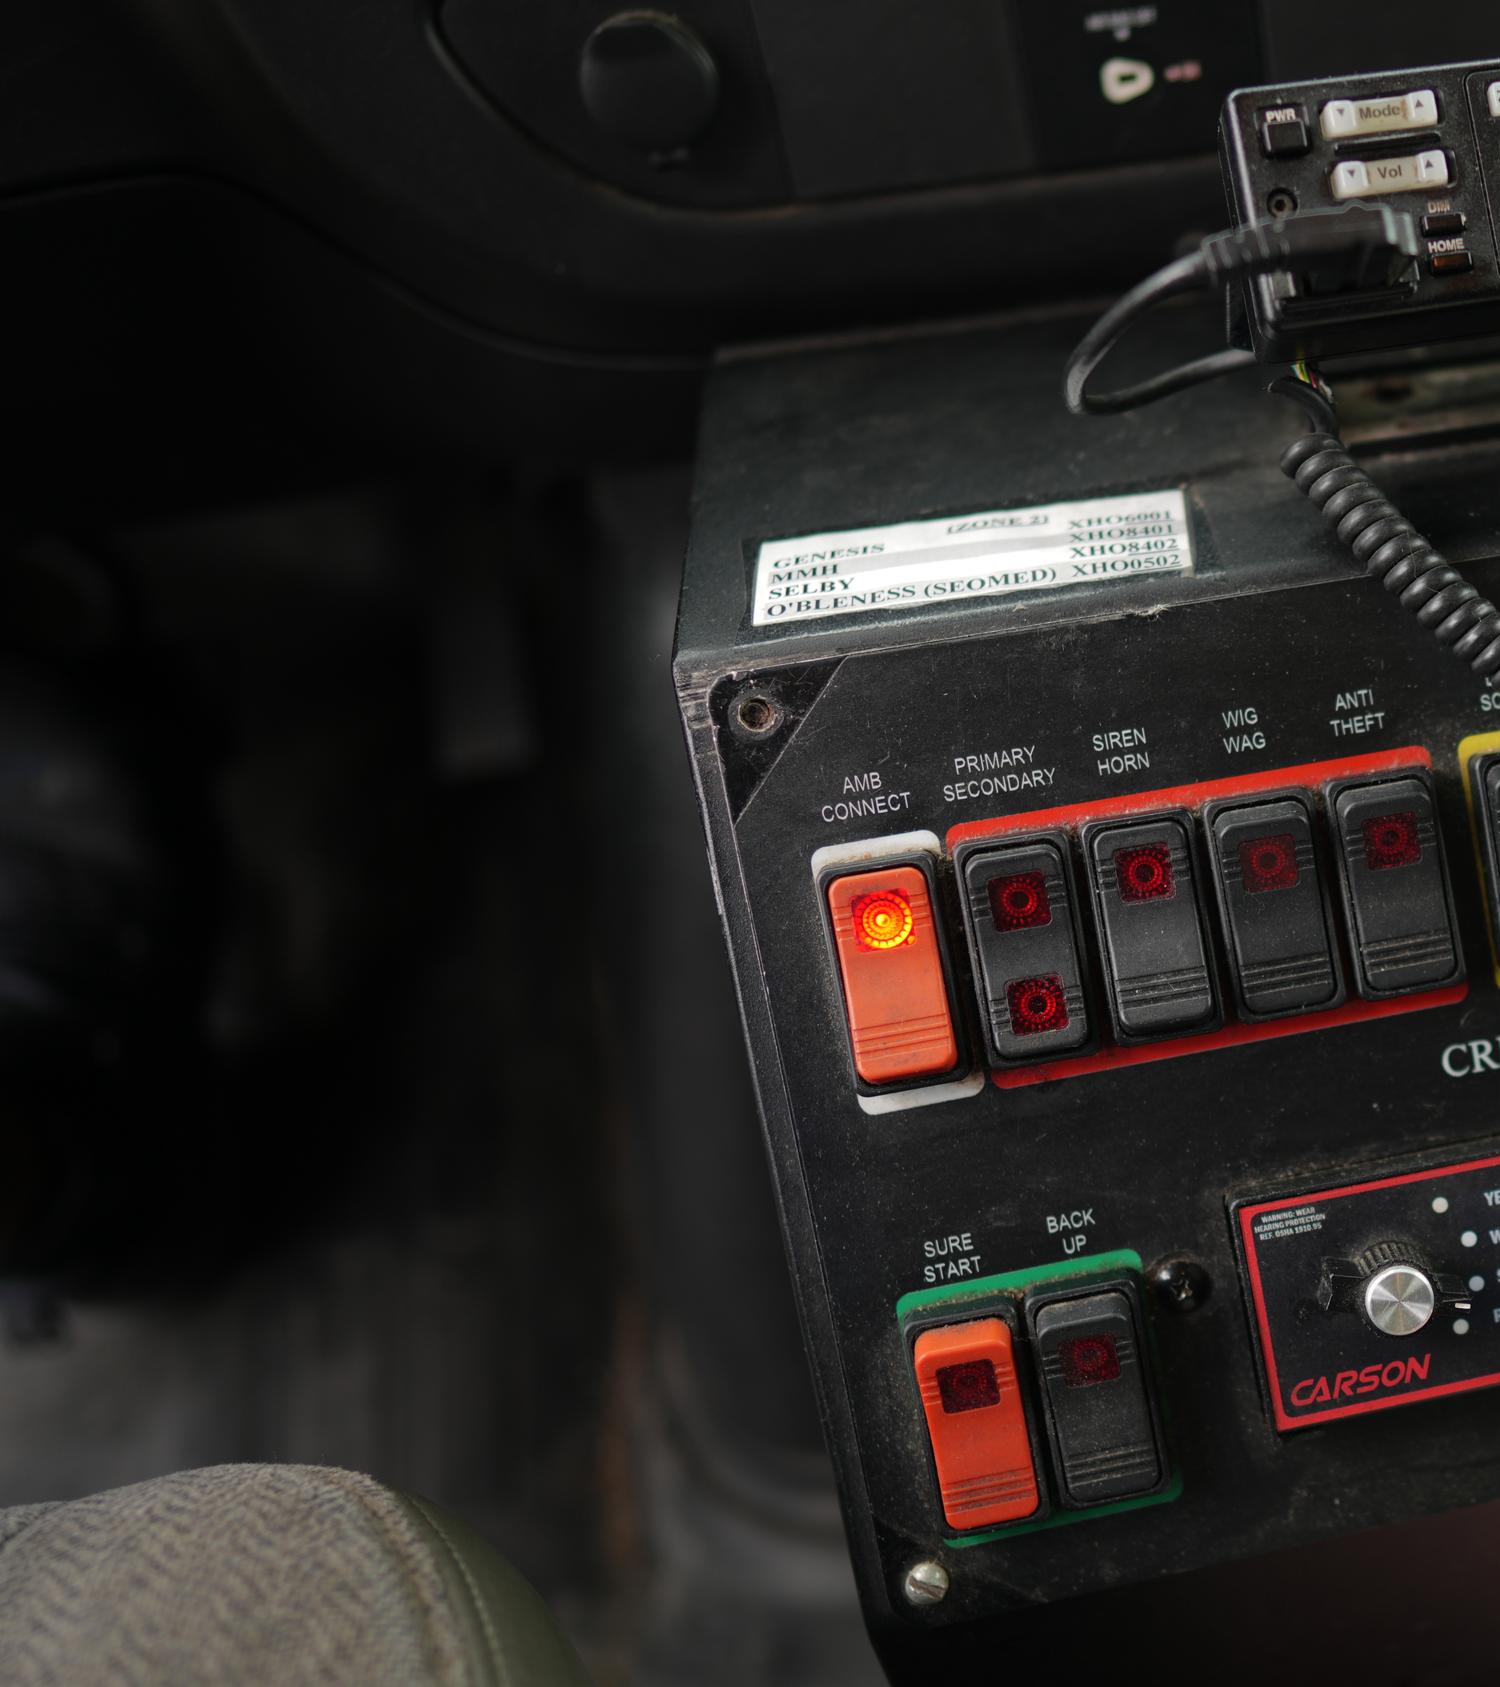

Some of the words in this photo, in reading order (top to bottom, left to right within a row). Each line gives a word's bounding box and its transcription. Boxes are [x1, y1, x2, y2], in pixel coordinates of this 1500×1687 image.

[1265, 108, 1296, 122] PWR
[1359, 103, 1400, 120] Mode
[1377, 165, 1402, 180] Vol
[1427, 201, 1450, 214] DIM
[1428, 238, 1464, 253] HOME
[771, 564, 839, 584] MMH
[1070, 524, 1174, 543] XHO8401
[774, 543, 885, 569] GENESIS
[769, 577, 854, 600] SELBY
[1070, 538, 1178, 559] XHO8402
[767, 584, 916, 618] O'BLENESS
[924, 567, 1058, 598] (SEOMED)
[1072, 554, 1181, 577] XHO0502
[1335, 689, 1374, 712] ANTI
[1222, 707, 1258, 729] WIG
[1330, 712, 1385, 737] THEFT
[1092, 727, 1147, 752] SIREN
[1223, 732, 1266, 754] WAG
[954, 745, 1035, 775] PRIMARY
[1097, 752, 1150, 776] HORN
[842, 771, 882, 794] AMB
[943, 767, 1056, 802] SECONDARY
[821, 791, 911, 823] CONNECT
[1046, 1208, 1095, 1234] BACK
[1254, 1220, 1285, 1233] HEARING
[1285, 1213, 1326, 1228] PROTECTION
[1296, 1207, 1316, 1217] WEAR
[924, 1232, 974, 1258] SURE
[1062, 1234, 1086, 1254] UP
[923, 1256, 981, 1283] START
[1290, 1352, 1431, 1407] CARSON
